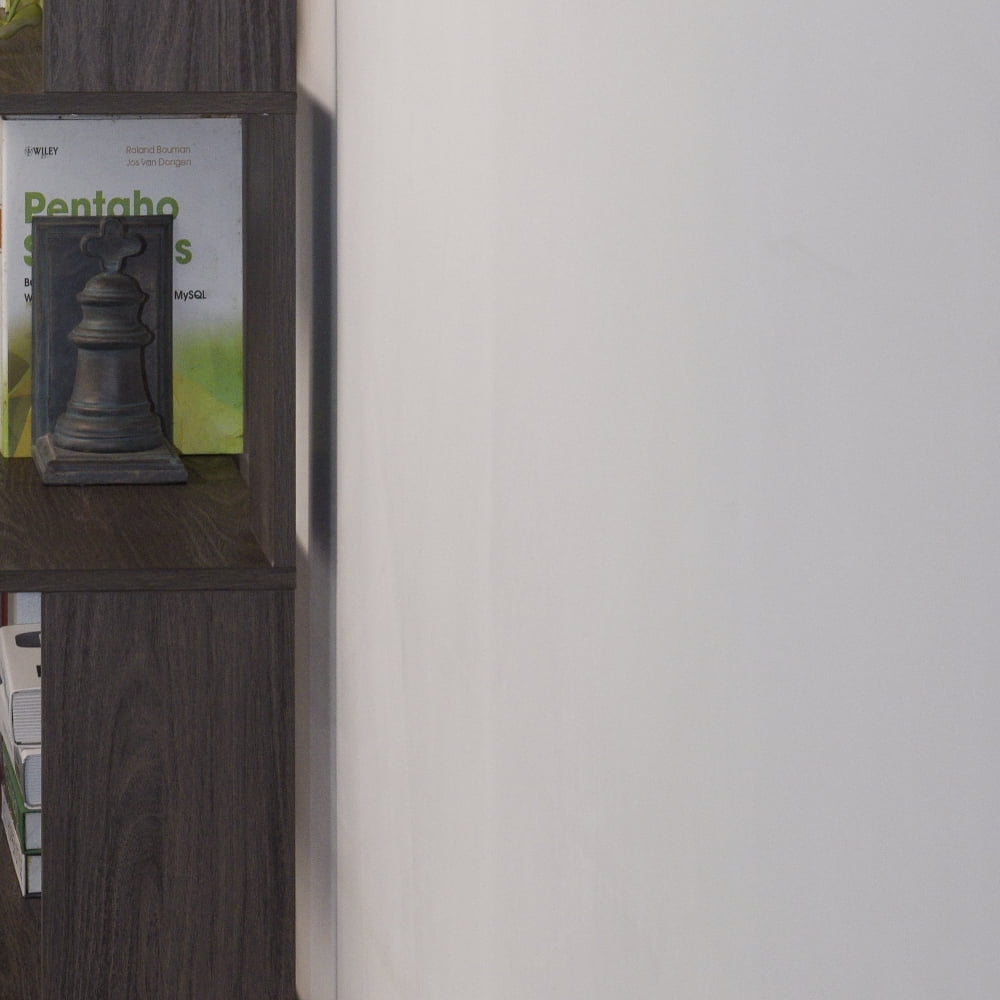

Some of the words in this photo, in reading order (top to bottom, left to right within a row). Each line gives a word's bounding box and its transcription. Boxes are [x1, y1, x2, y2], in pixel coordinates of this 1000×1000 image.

[33, 146, 59, 159] WILEY
[126, 145, 155, 154] Roland
[157, 146, 191, 154] Bouman
[126, 158, 140, 167] Jos
[158, 158, 192, 168] Dongen
[24, 190, 179, 224] Pentaho
[174, 289, 207, 302] MySQL
